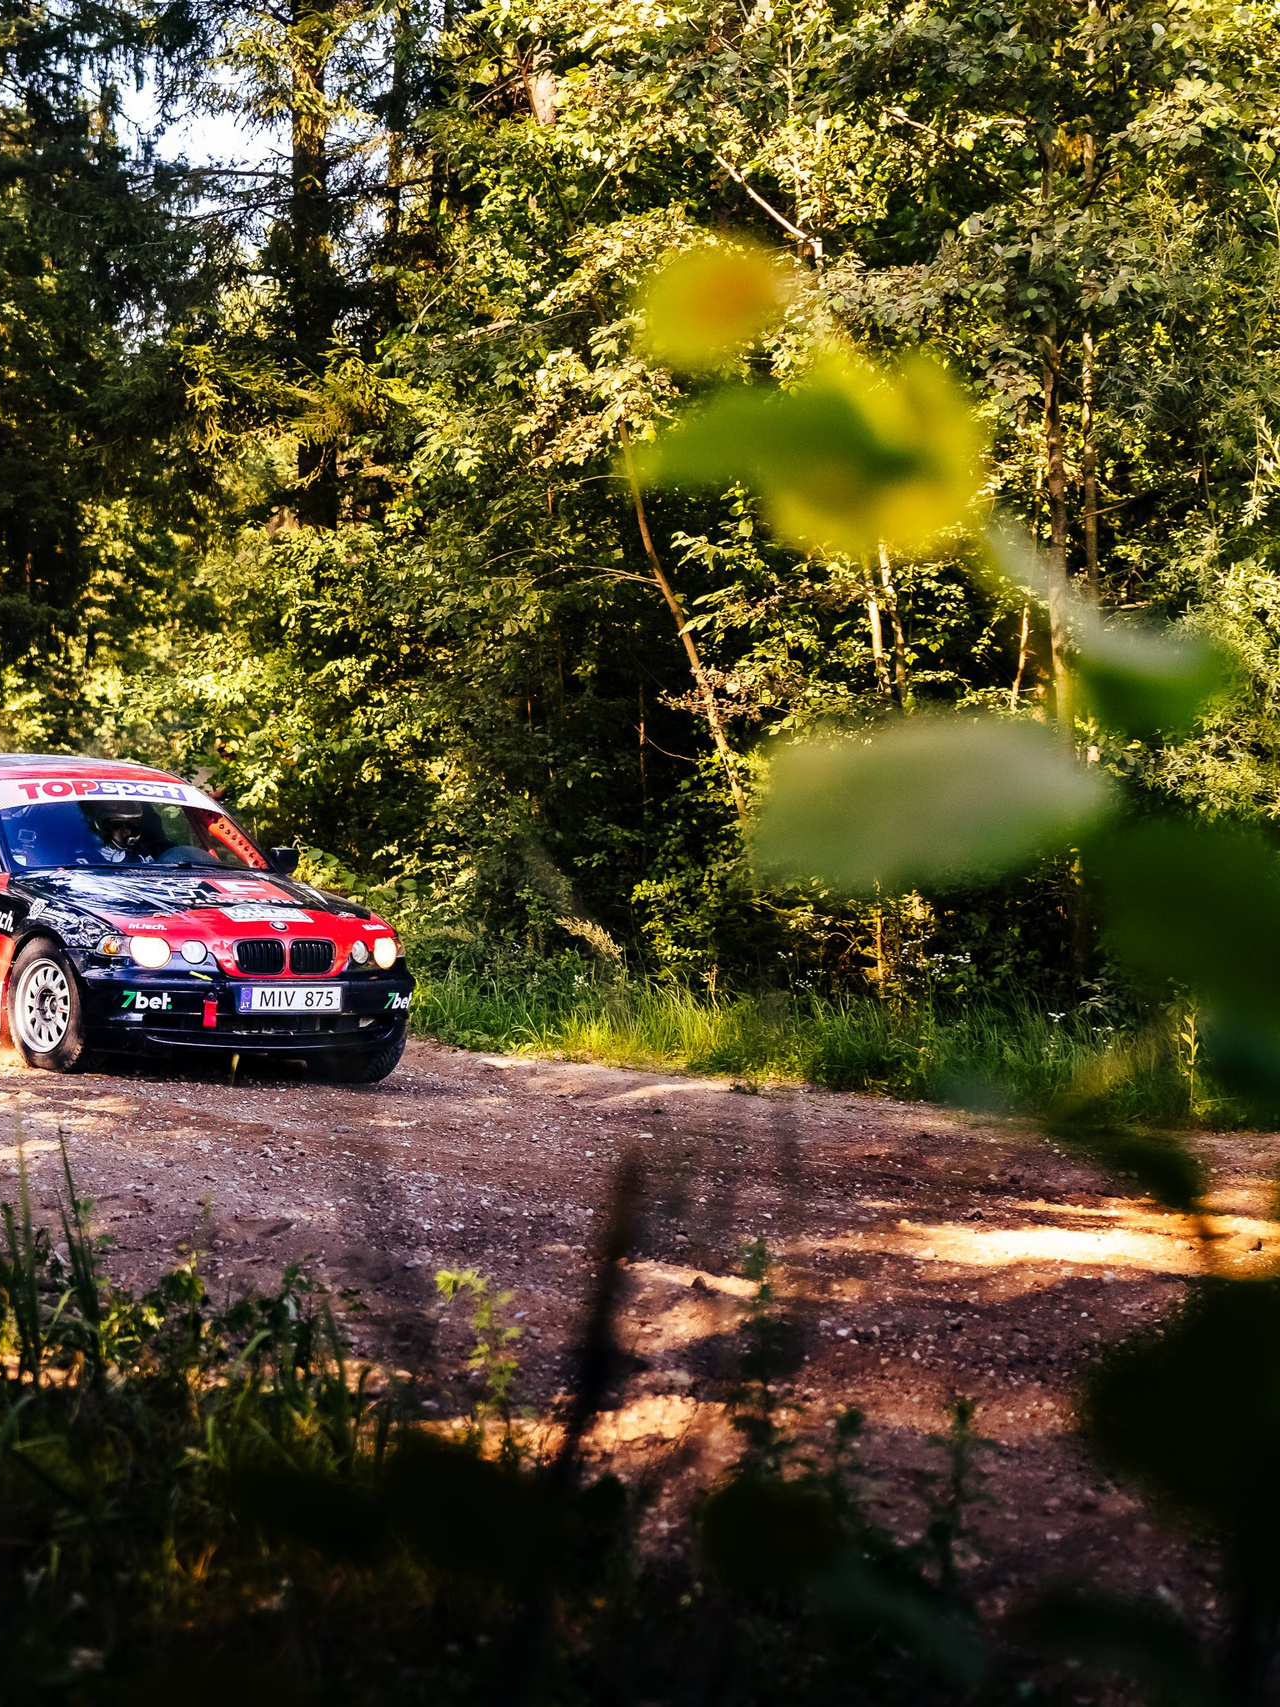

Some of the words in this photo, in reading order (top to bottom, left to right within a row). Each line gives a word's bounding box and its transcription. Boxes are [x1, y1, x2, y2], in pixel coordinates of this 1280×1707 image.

[18, 781, 181, 800] TOPsport
[259, 991, 296, 1007] MIV
[304, 991, 333, 1007] 875
